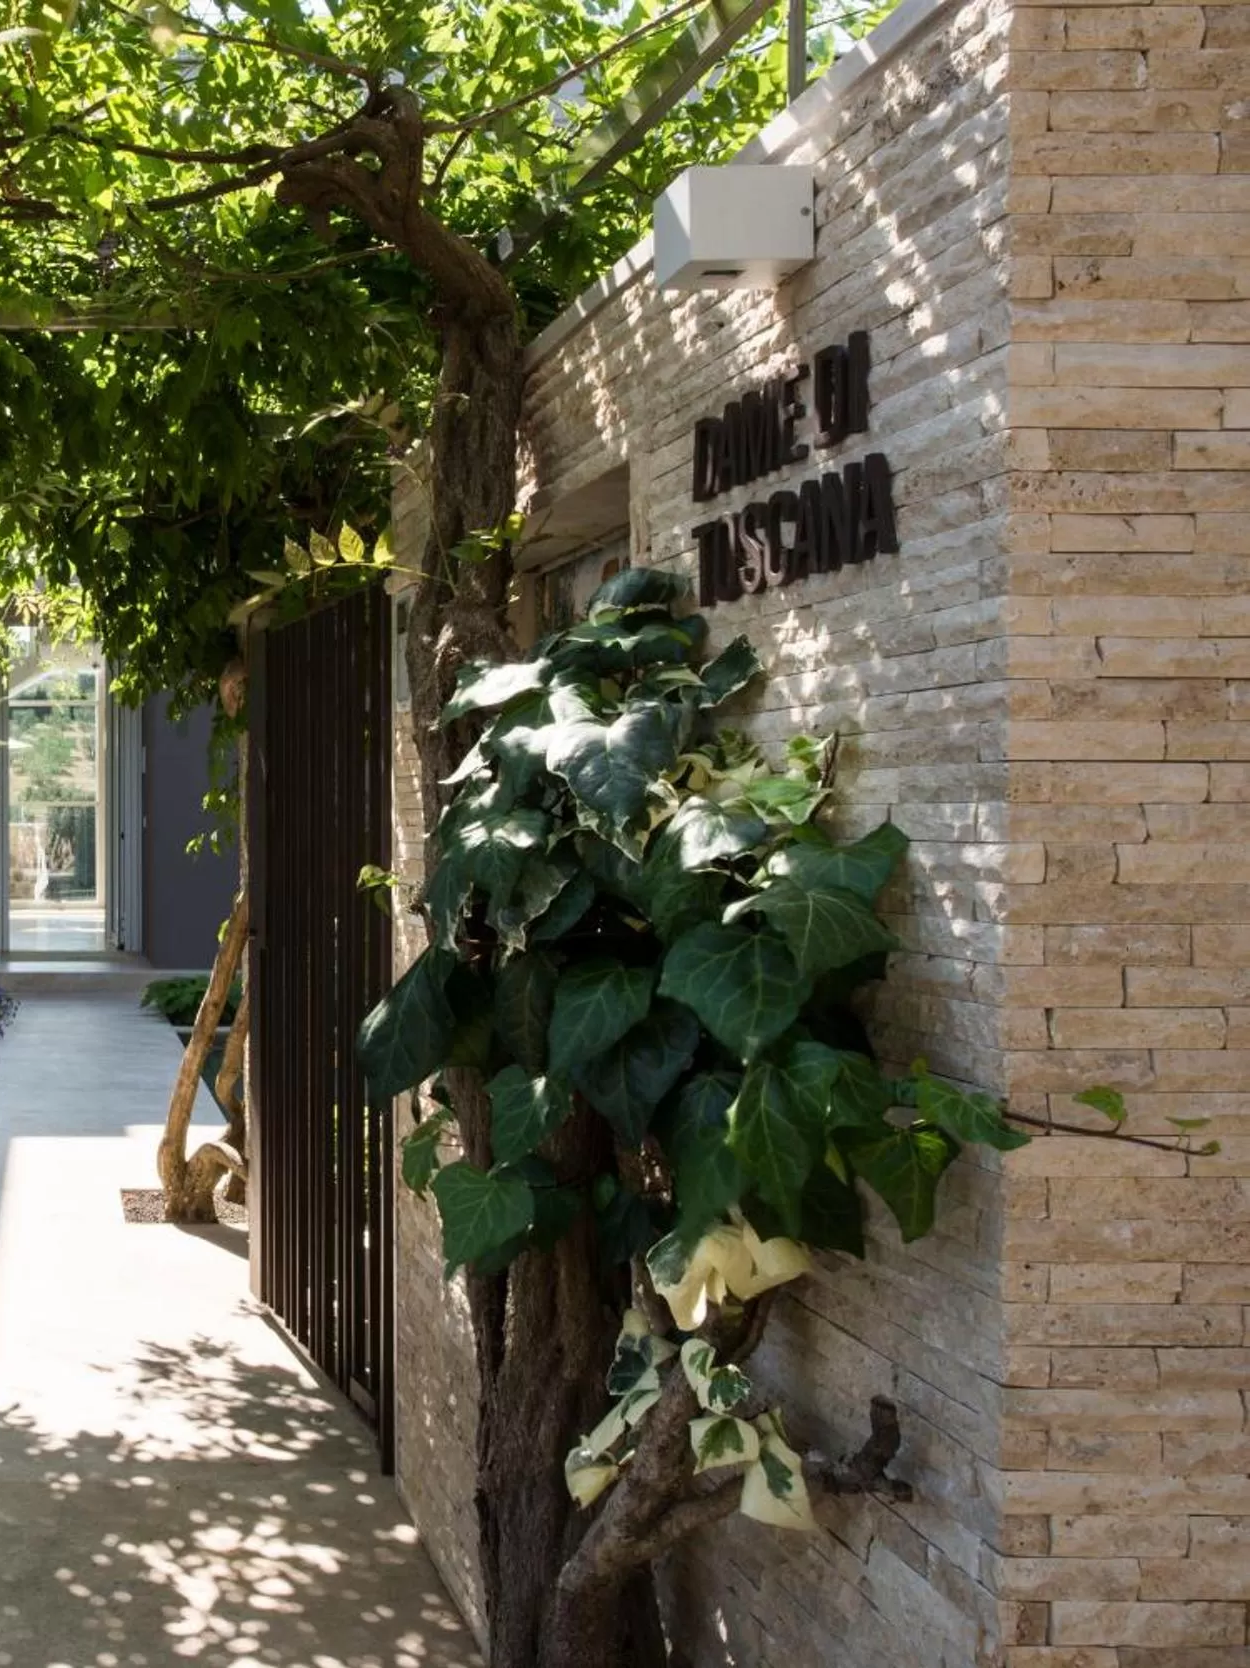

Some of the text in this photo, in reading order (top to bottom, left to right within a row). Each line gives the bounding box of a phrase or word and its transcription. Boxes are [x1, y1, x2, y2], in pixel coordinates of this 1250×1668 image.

[693, 330, 870, 503] DAME DI
[691, 452, 900, 607] TOSCANA
